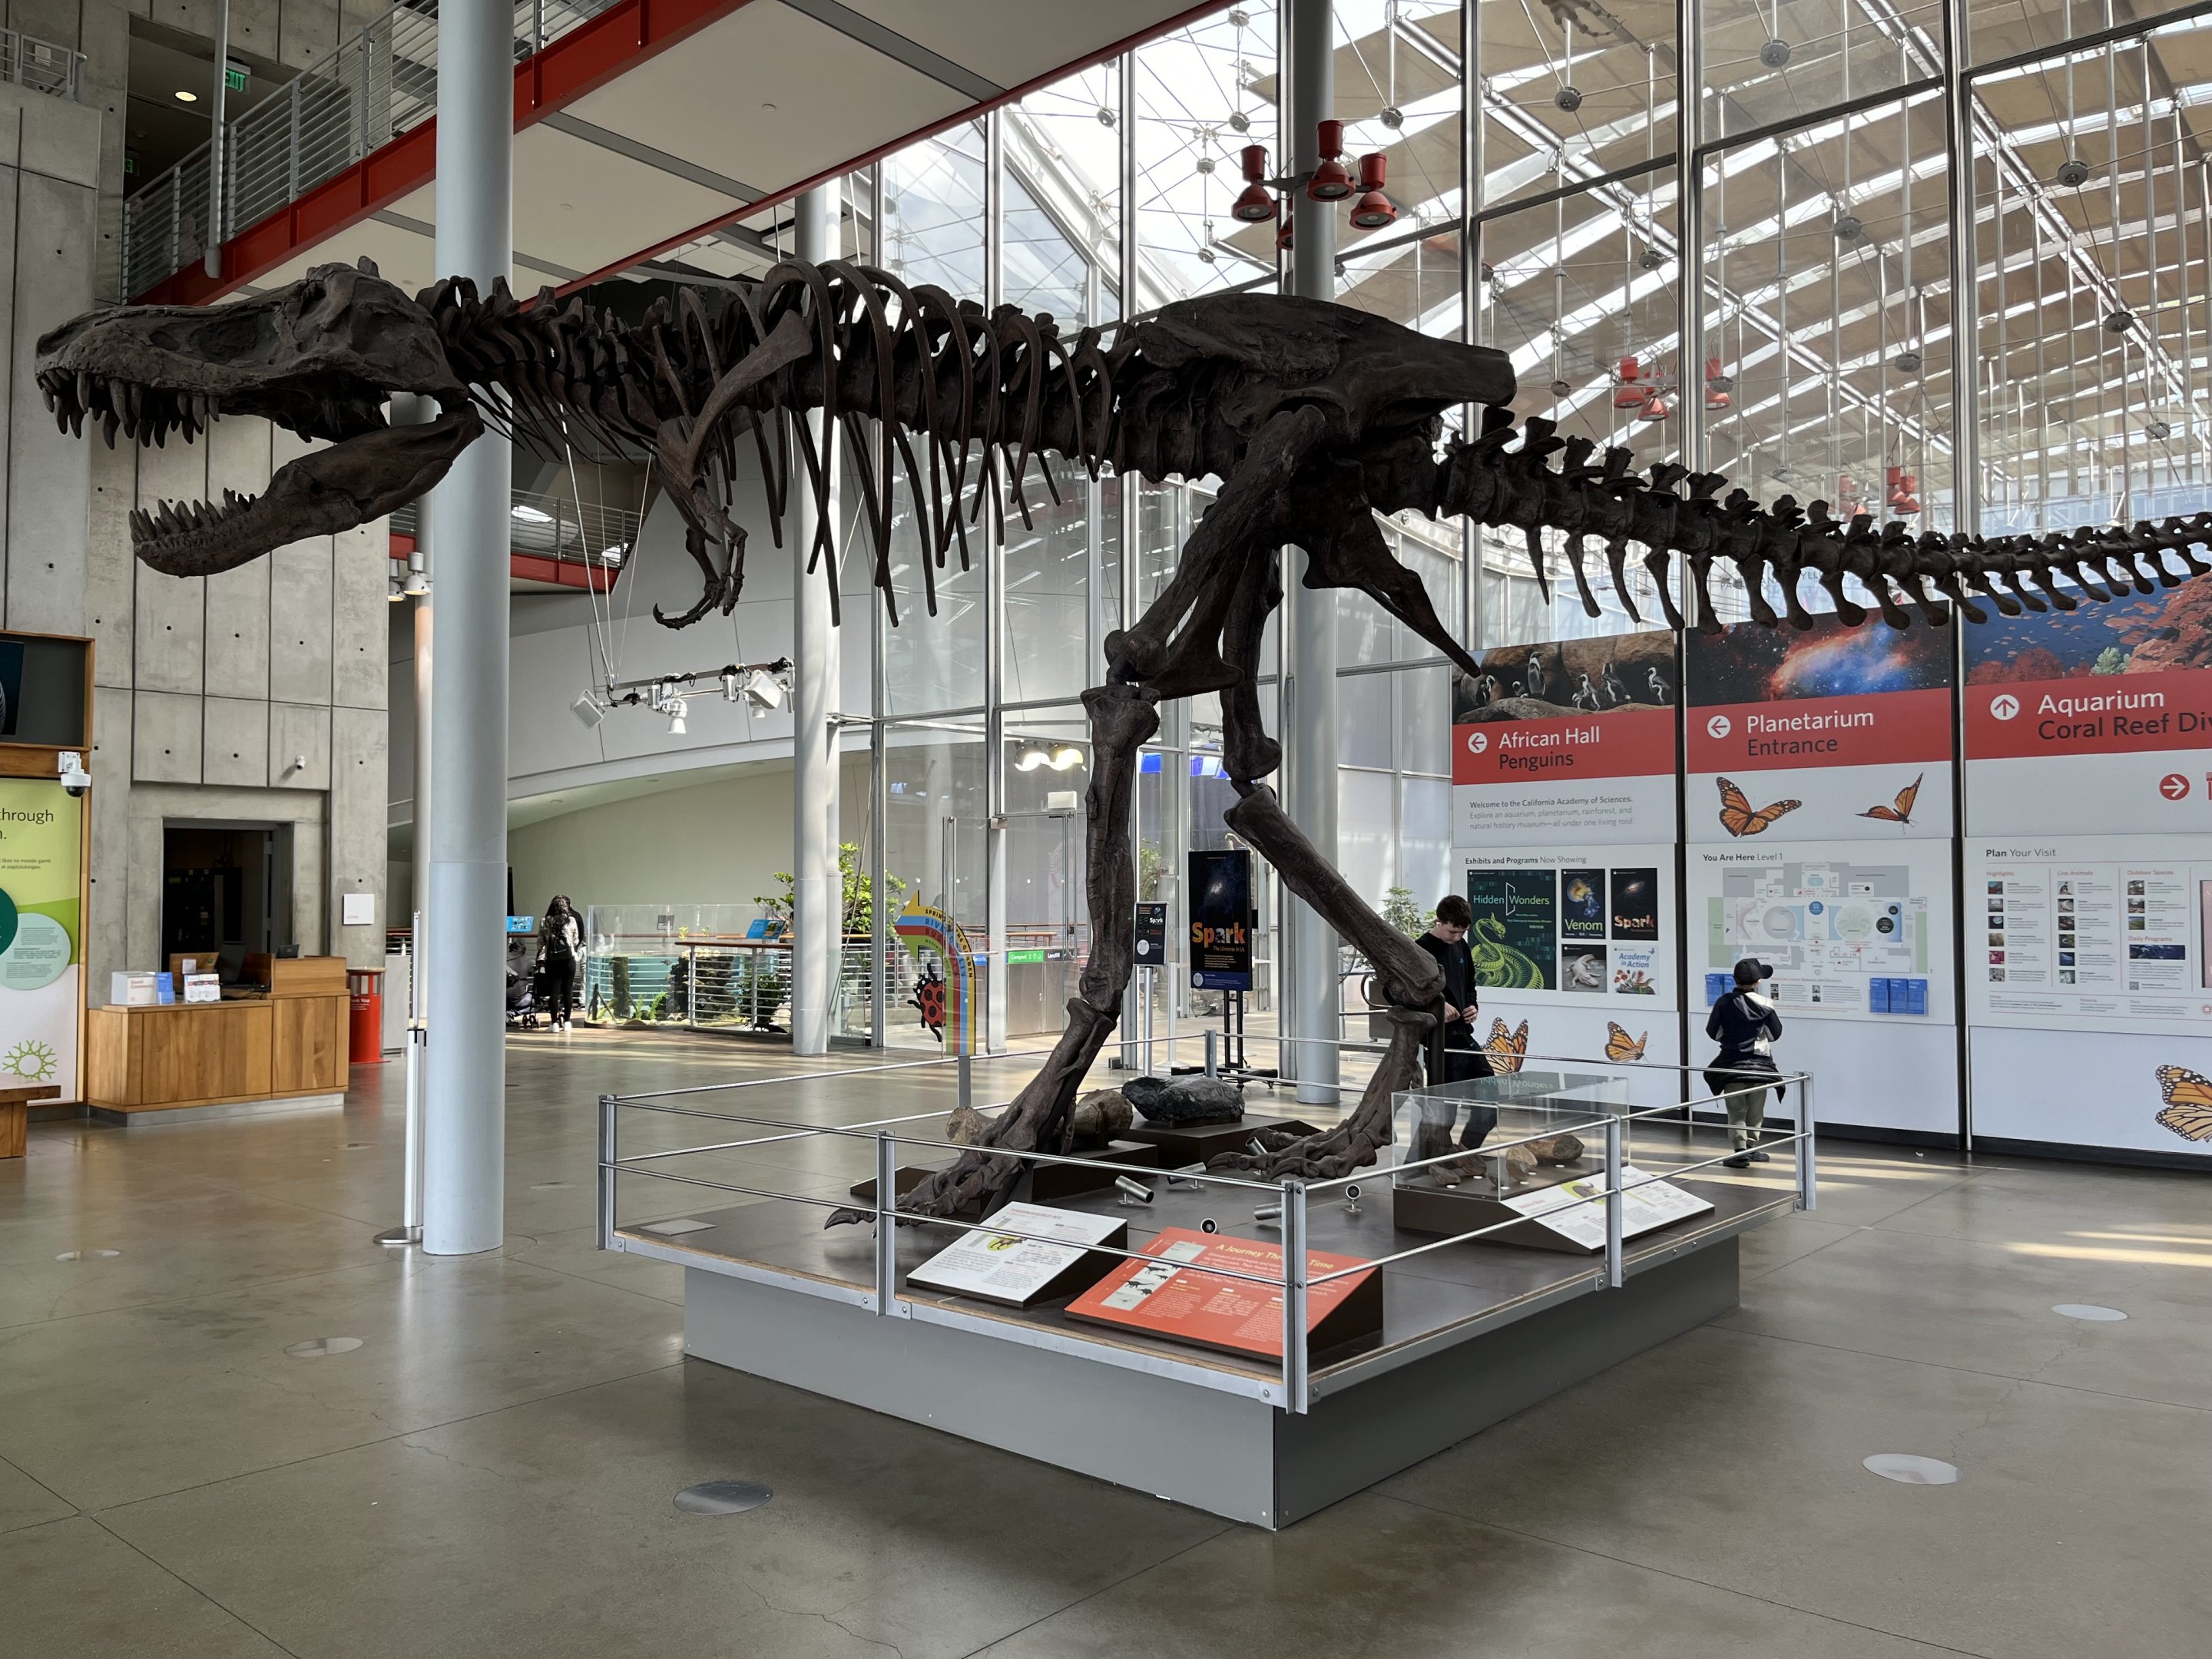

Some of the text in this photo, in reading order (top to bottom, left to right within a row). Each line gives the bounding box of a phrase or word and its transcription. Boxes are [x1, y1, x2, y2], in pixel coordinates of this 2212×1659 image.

[2038, 690, 2164, 717] Aquarium
[1747, 710, 1874, 734] Planetarium
[2038, 717, 2103, 740] Coral
[2114, 713, 2169, 736] Reef
[1498, 726, 1601, 749] African Hall
[1748, 738, 1838, 757] Entrance
[1499, 752, 1574, 771] Penguins
[1557, 797, 1588, 806] Academy
[1504, 811, 1537, 820] aquarium,
[1538, 809, 1580, 818] planetarium,
[1582, 807, 1617, 816] rainforest,
[1493, 822, 1515, 830] history
[1562, 819, 1581, 827] under
[1598, 818, 1617, 827] living
[1703, 853, 1717, 862] You
[1757, 853, 1777, 861] Level
[1986, 849, 2007, 857] Plan
[2034, 848, 2057, 856] Visit
[1506, 856, 1538, 865] Programs
[1557, 856, 1587, 865] Showing
[1473, 895, 1550, 905] Hidden Wonders
[1565, 919, 1603, 931] Venom
[1614, 914, 1654, 929] Spark
[1192, 922, 1246, 949] Spark
[1618, 953, 1651, 962] Academy
[1225, 1245, 1263, 1257] Journey
[1309, 1260, 1334, 1269] Time
